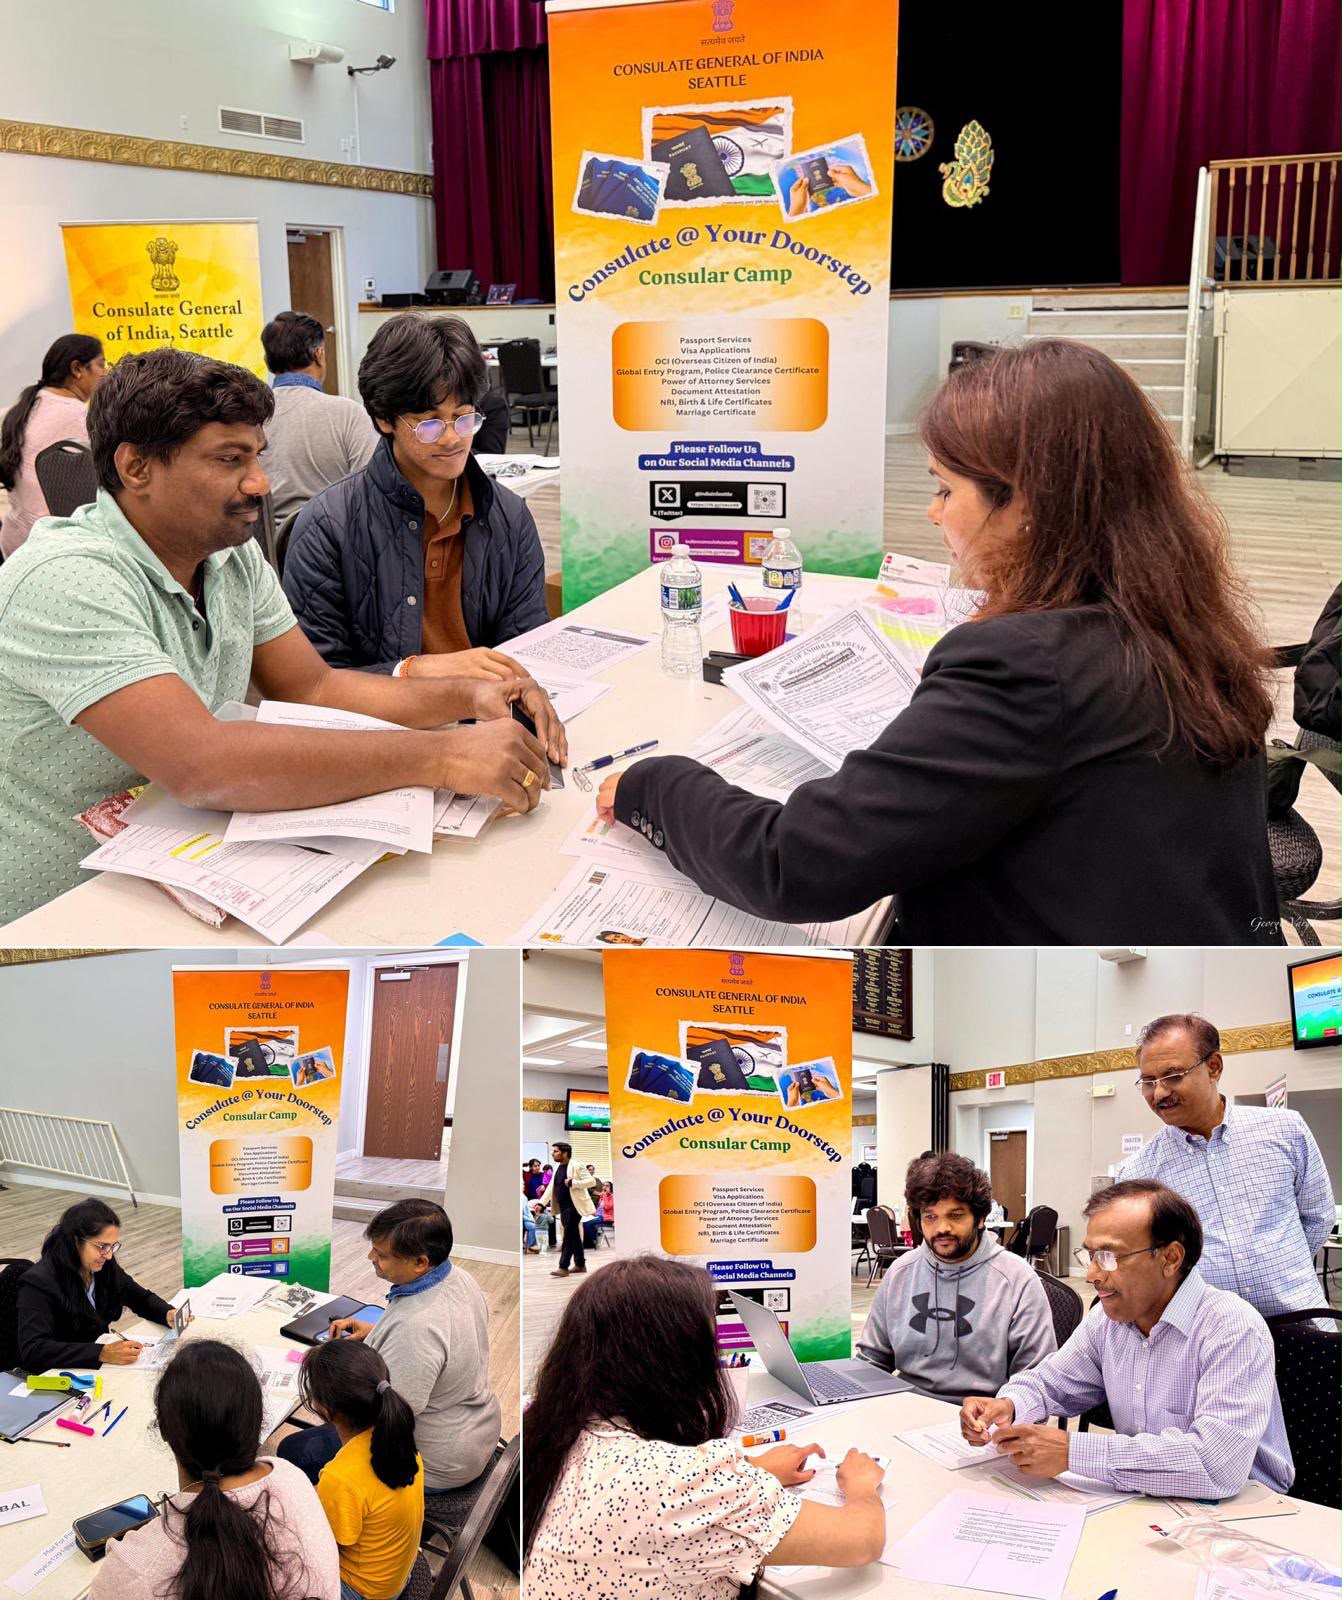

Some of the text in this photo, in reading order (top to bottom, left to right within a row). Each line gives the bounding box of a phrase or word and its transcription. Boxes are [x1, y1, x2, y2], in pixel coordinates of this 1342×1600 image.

[613, 48, 824, 77] CONSULATE GENERAL OF INDIA
[688, 74, 747, 89] SEATTLE
[568, 224, 872, 302] Consulate @ Your Doorstep
[639, 267, 792, 286] Consular Camp
[92, 300, 242, 318] Consulate General
[106, 324, 233, 342] of India, Seattle
[753, 356, 777, 364] India)
[644, 369, 665, 377] Entry
[667, 368, 703, 376] Program,
[698, 378, 734, 386] Attorney
[674, 445, 757, 454] Please Follow Us
[658, 458, 677, 466] Our
[679, 458, 709, 467] Social
[711, 458, 741, 467] Media
[743, 459, 791, 468] Channels
[655, 987, 806, 1005] CONSULATE GENERAL OF INDIA
[209, 1002, 251, 1010] CONSULATE
[713, 1004, 755, 1015] SEATTLE
[185, 1089, 332, 1130] Consulate @ Your Doorstep
[223, 1111, 297, 1121] Consular Camp
[622, 1108, 842, 1164] Consulate @ Your Doorstep
[680, 1137, 791, 1153] Consular Camp
[737, 1271, 759, 1279] Media
